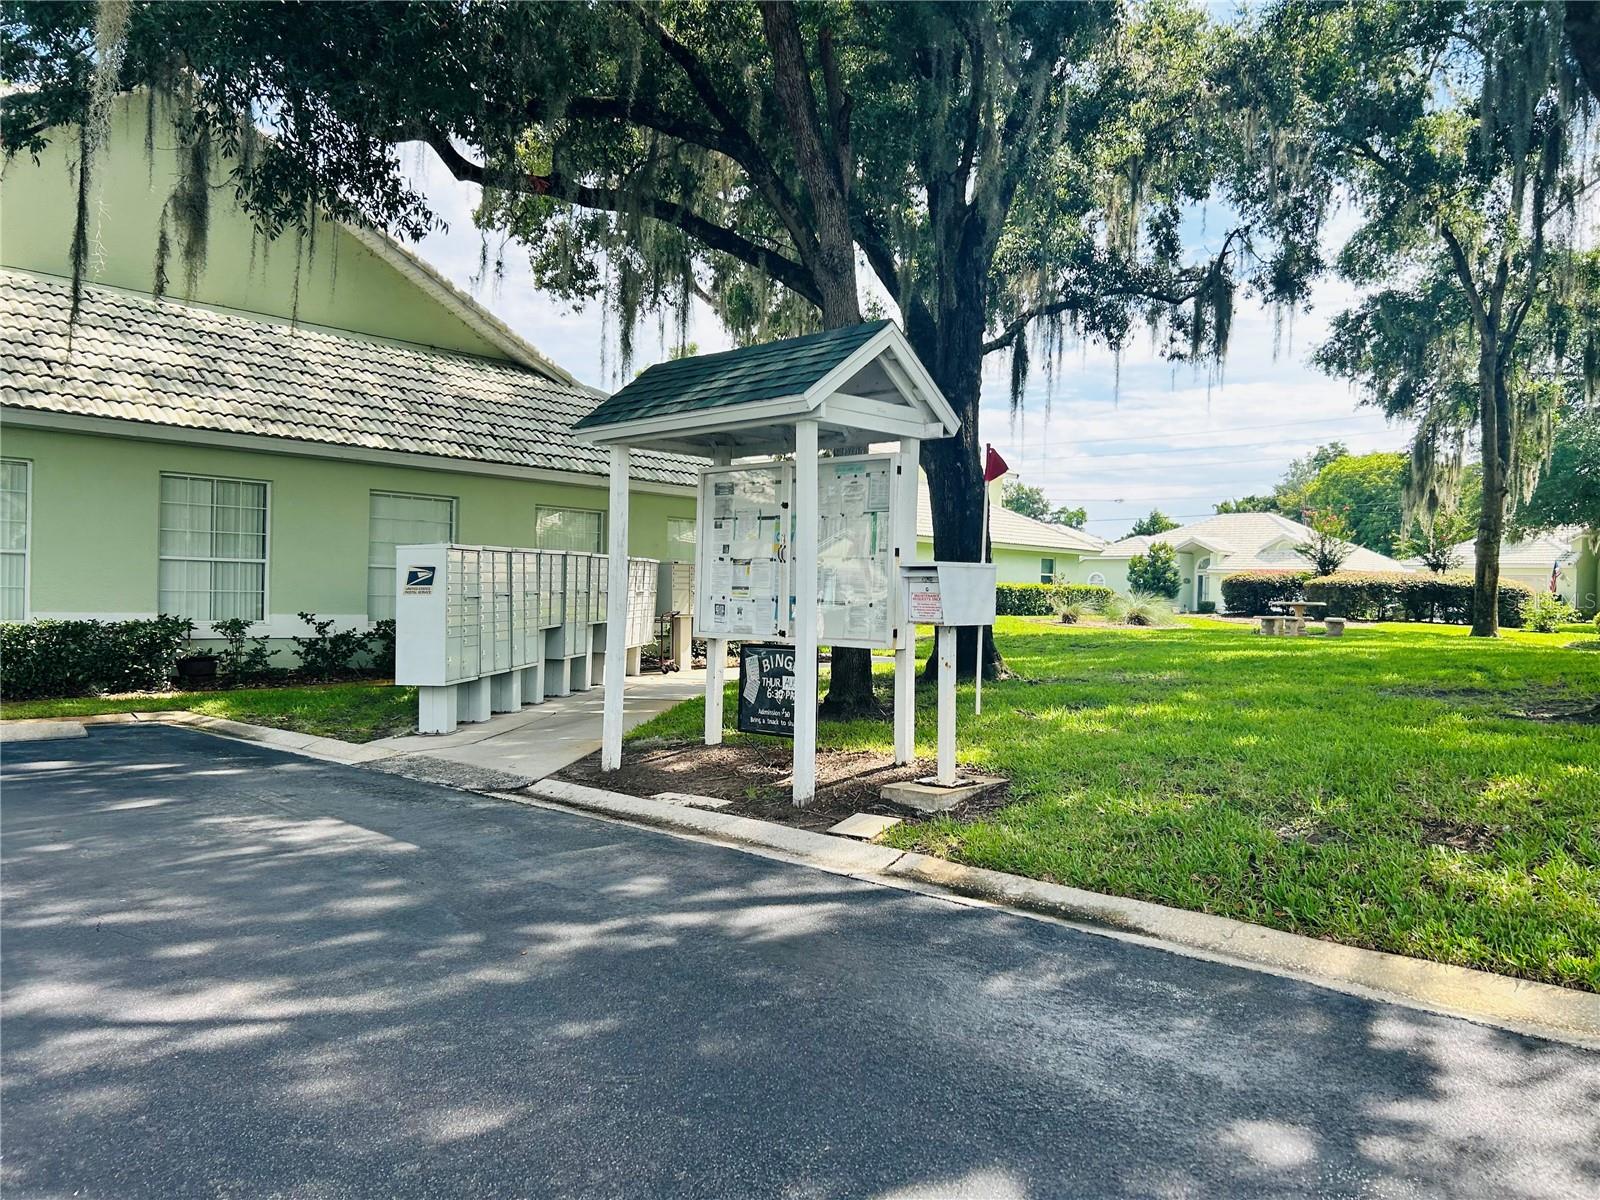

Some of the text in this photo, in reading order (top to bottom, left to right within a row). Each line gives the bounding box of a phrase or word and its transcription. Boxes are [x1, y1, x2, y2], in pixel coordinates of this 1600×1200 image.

[762, 654, 794, 672] BING
[767, 690, 783, 699] 6:30
[758, 708, 780, 716] Admission
